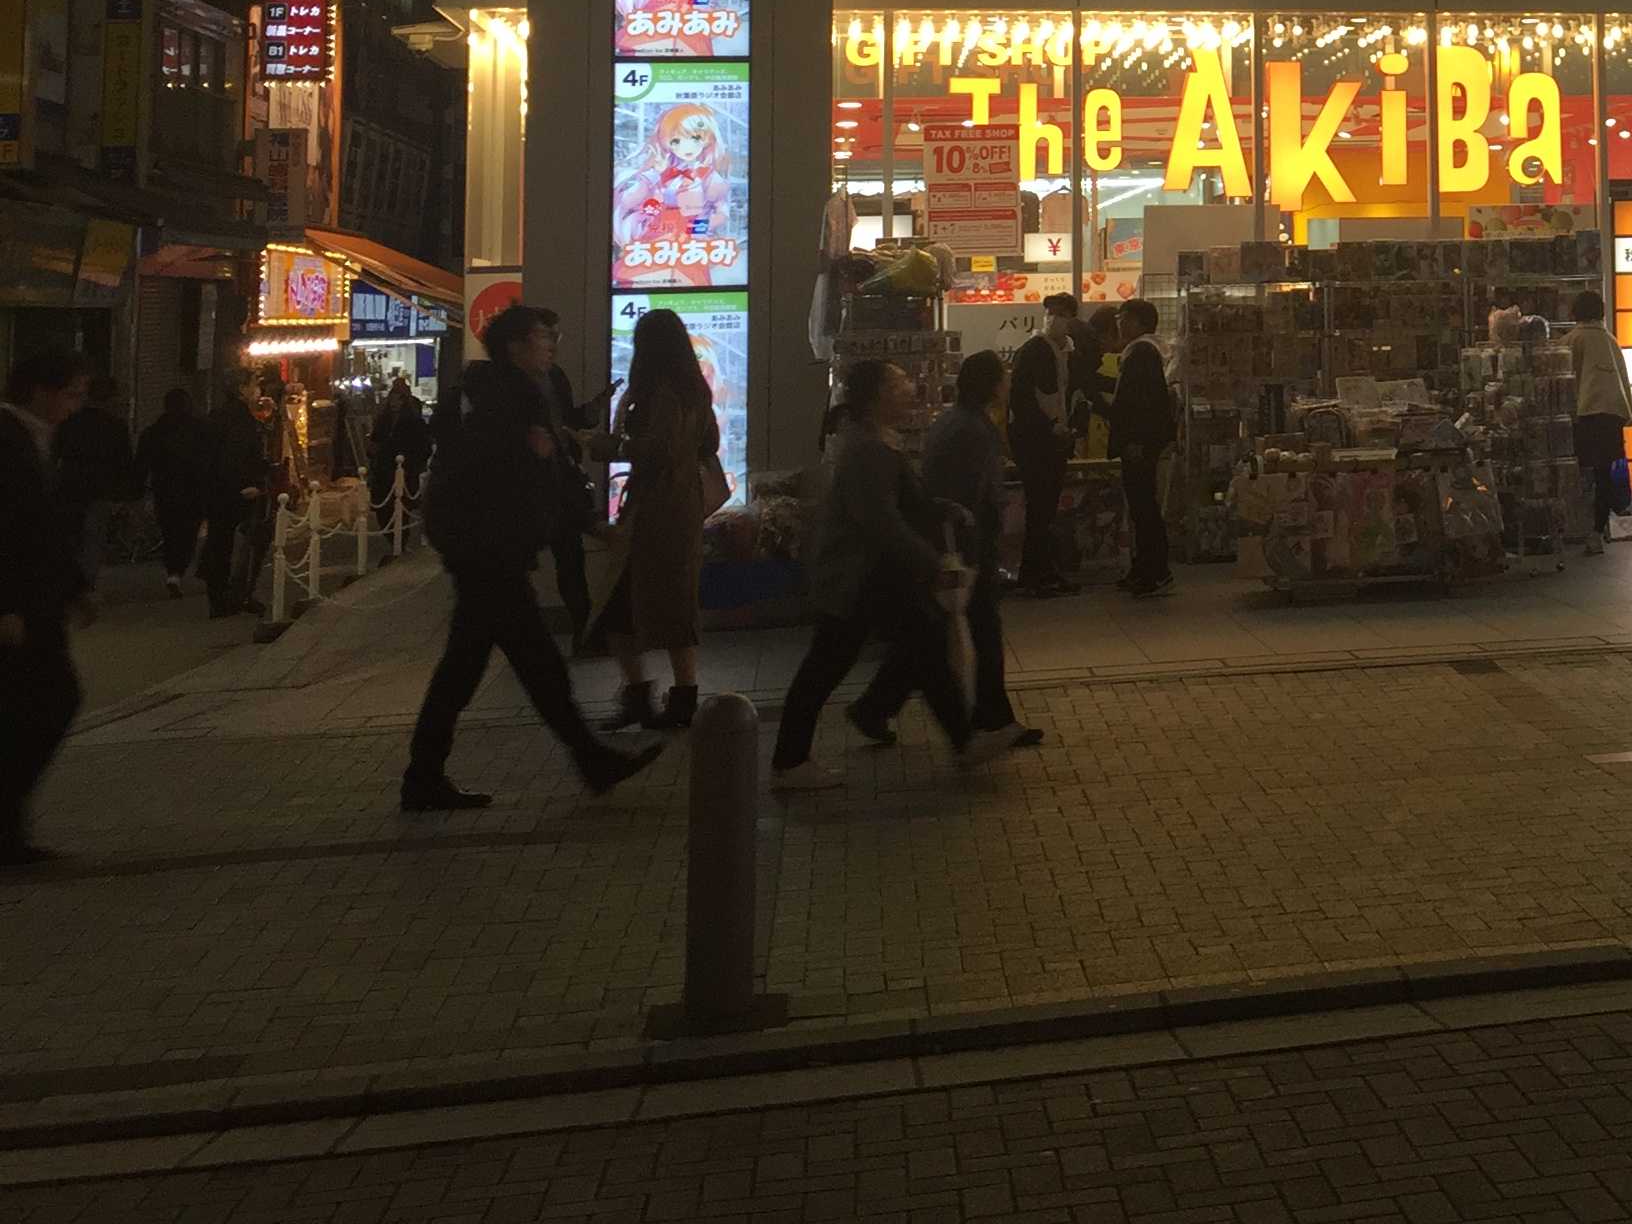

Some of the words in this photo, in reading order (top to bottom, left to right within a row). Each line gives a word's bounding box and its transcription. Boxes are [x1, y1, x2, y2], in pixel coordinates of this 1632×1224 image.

[269, 6, 285, 18] 1F
[289, 5, 321, 17] トレカ
[626, 9, 741, 38] あみあみ
[267, 45, 284, 57] B1
[288, 45, 320, 56] トレカ
[622, 69, 649, 87] 4F
[929, 129, 952, 139] TAX
[955, 129, 982, 138] FREE
[985, 128, 1015, 138] SHOP
[949, 77, 1123, 183] The
[623, 240, 738, 268] あみあみ
